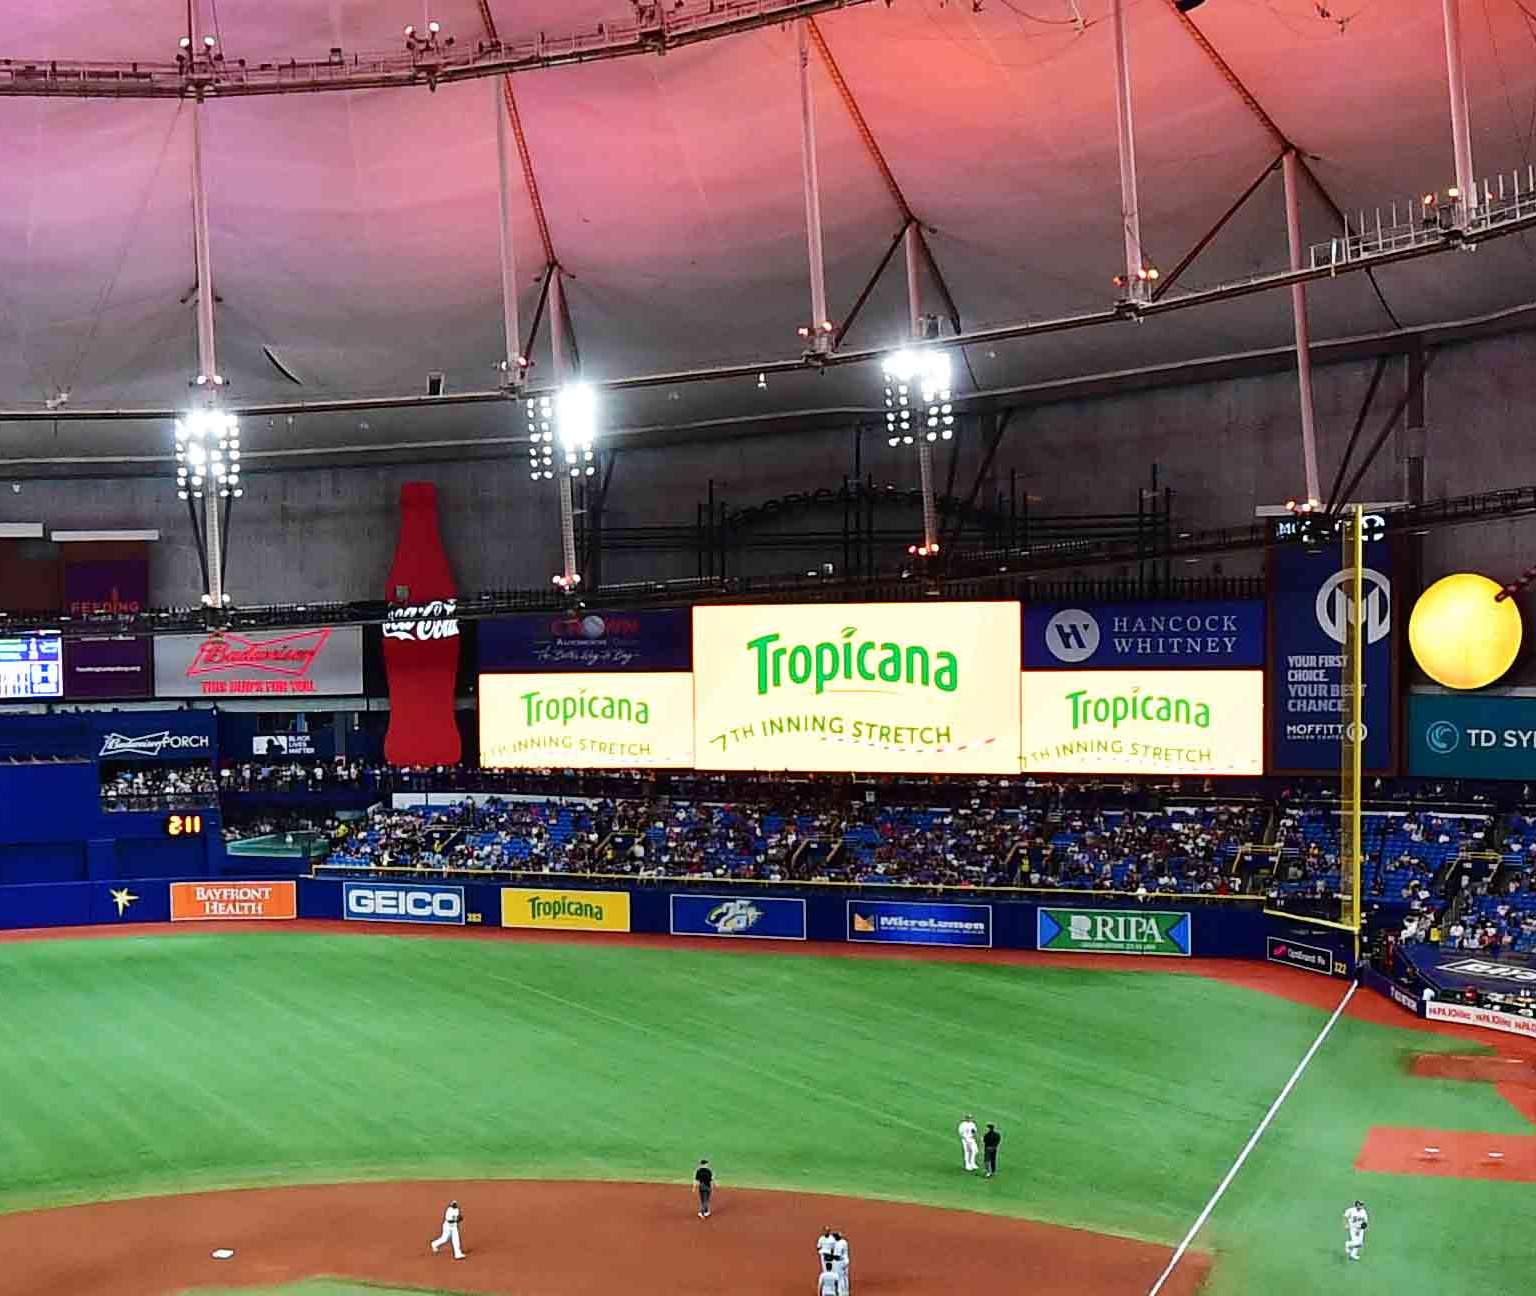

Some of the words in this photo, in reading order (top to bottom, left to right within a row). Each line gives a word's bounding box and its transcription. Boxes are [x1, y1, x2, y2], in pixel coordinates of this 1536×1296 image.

[1113, 616, 1237, 632] HANCOCK
[1114, 637, 1237, 654] WHITNEY
[747, 626, 958, 696] Tropicana
[1288, 655, 1315, 668] YOUR
[1318, 655, 1349, 668] FIRST
[1288, 684, 1327, 698] YOUR
[521, 688, 649, 726] Tropicana
[1065, 685, 1210, 730] Tropicana
[710, 724, 755, 752] 7TH
[762, 715, 844, 736] INNING
[853, 721, 951, 745] STRETCH
[1286, 723, 1345, 735] MOFFITT
[162, 735, 209, 748] PORCH
[1467, 729, 1496, 748] TD
[1056, 739, 1123, 759] INNING
[1131, 743, 1211, 764] STRETCH
[196, 886, 272, 902] BAYFRONT
[204, 900, 265, 916] HEALTH
[348, 891, 462, 918] GEICO
[528, 894, 604, 922] Tropicana
[880, 916, 985, 930] MicroLumen
[1094, 916, 1164, 943] RIPA
